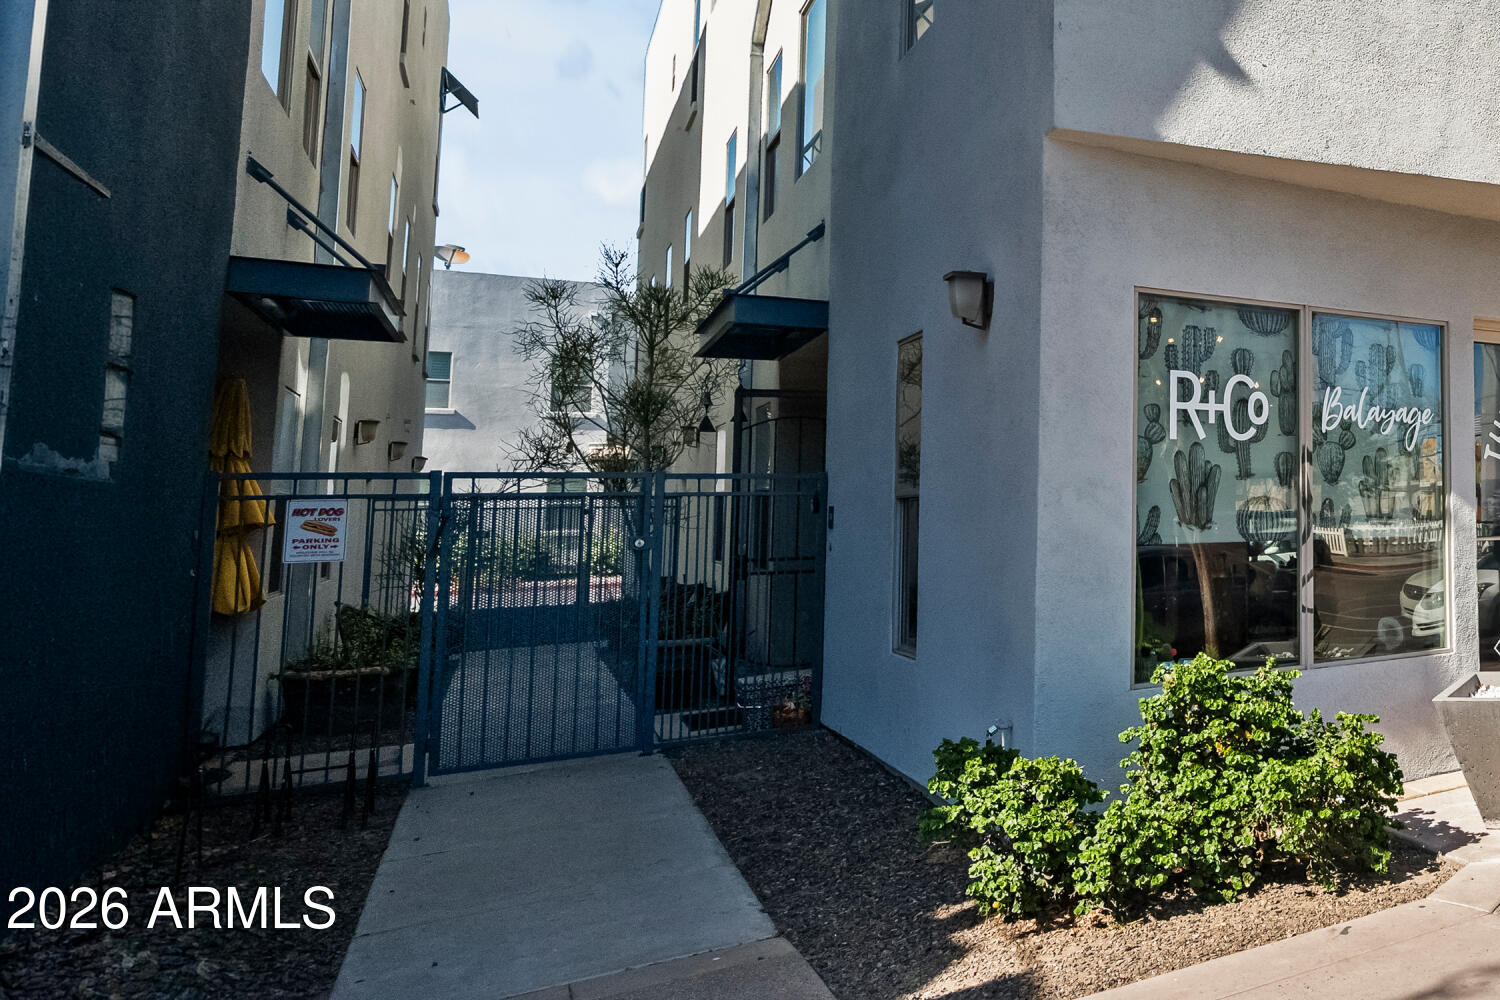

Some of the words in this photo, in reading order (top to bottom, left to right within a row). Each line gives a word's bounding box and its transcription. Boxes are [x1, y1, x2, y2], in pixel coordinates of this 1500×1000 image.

[1169, 370, 1269, 441] R+Co
[1322, 386, 1433, 451] Balayage
[292, 508, 318, 517] HOT
[318, 507, 345, 517] DOG
